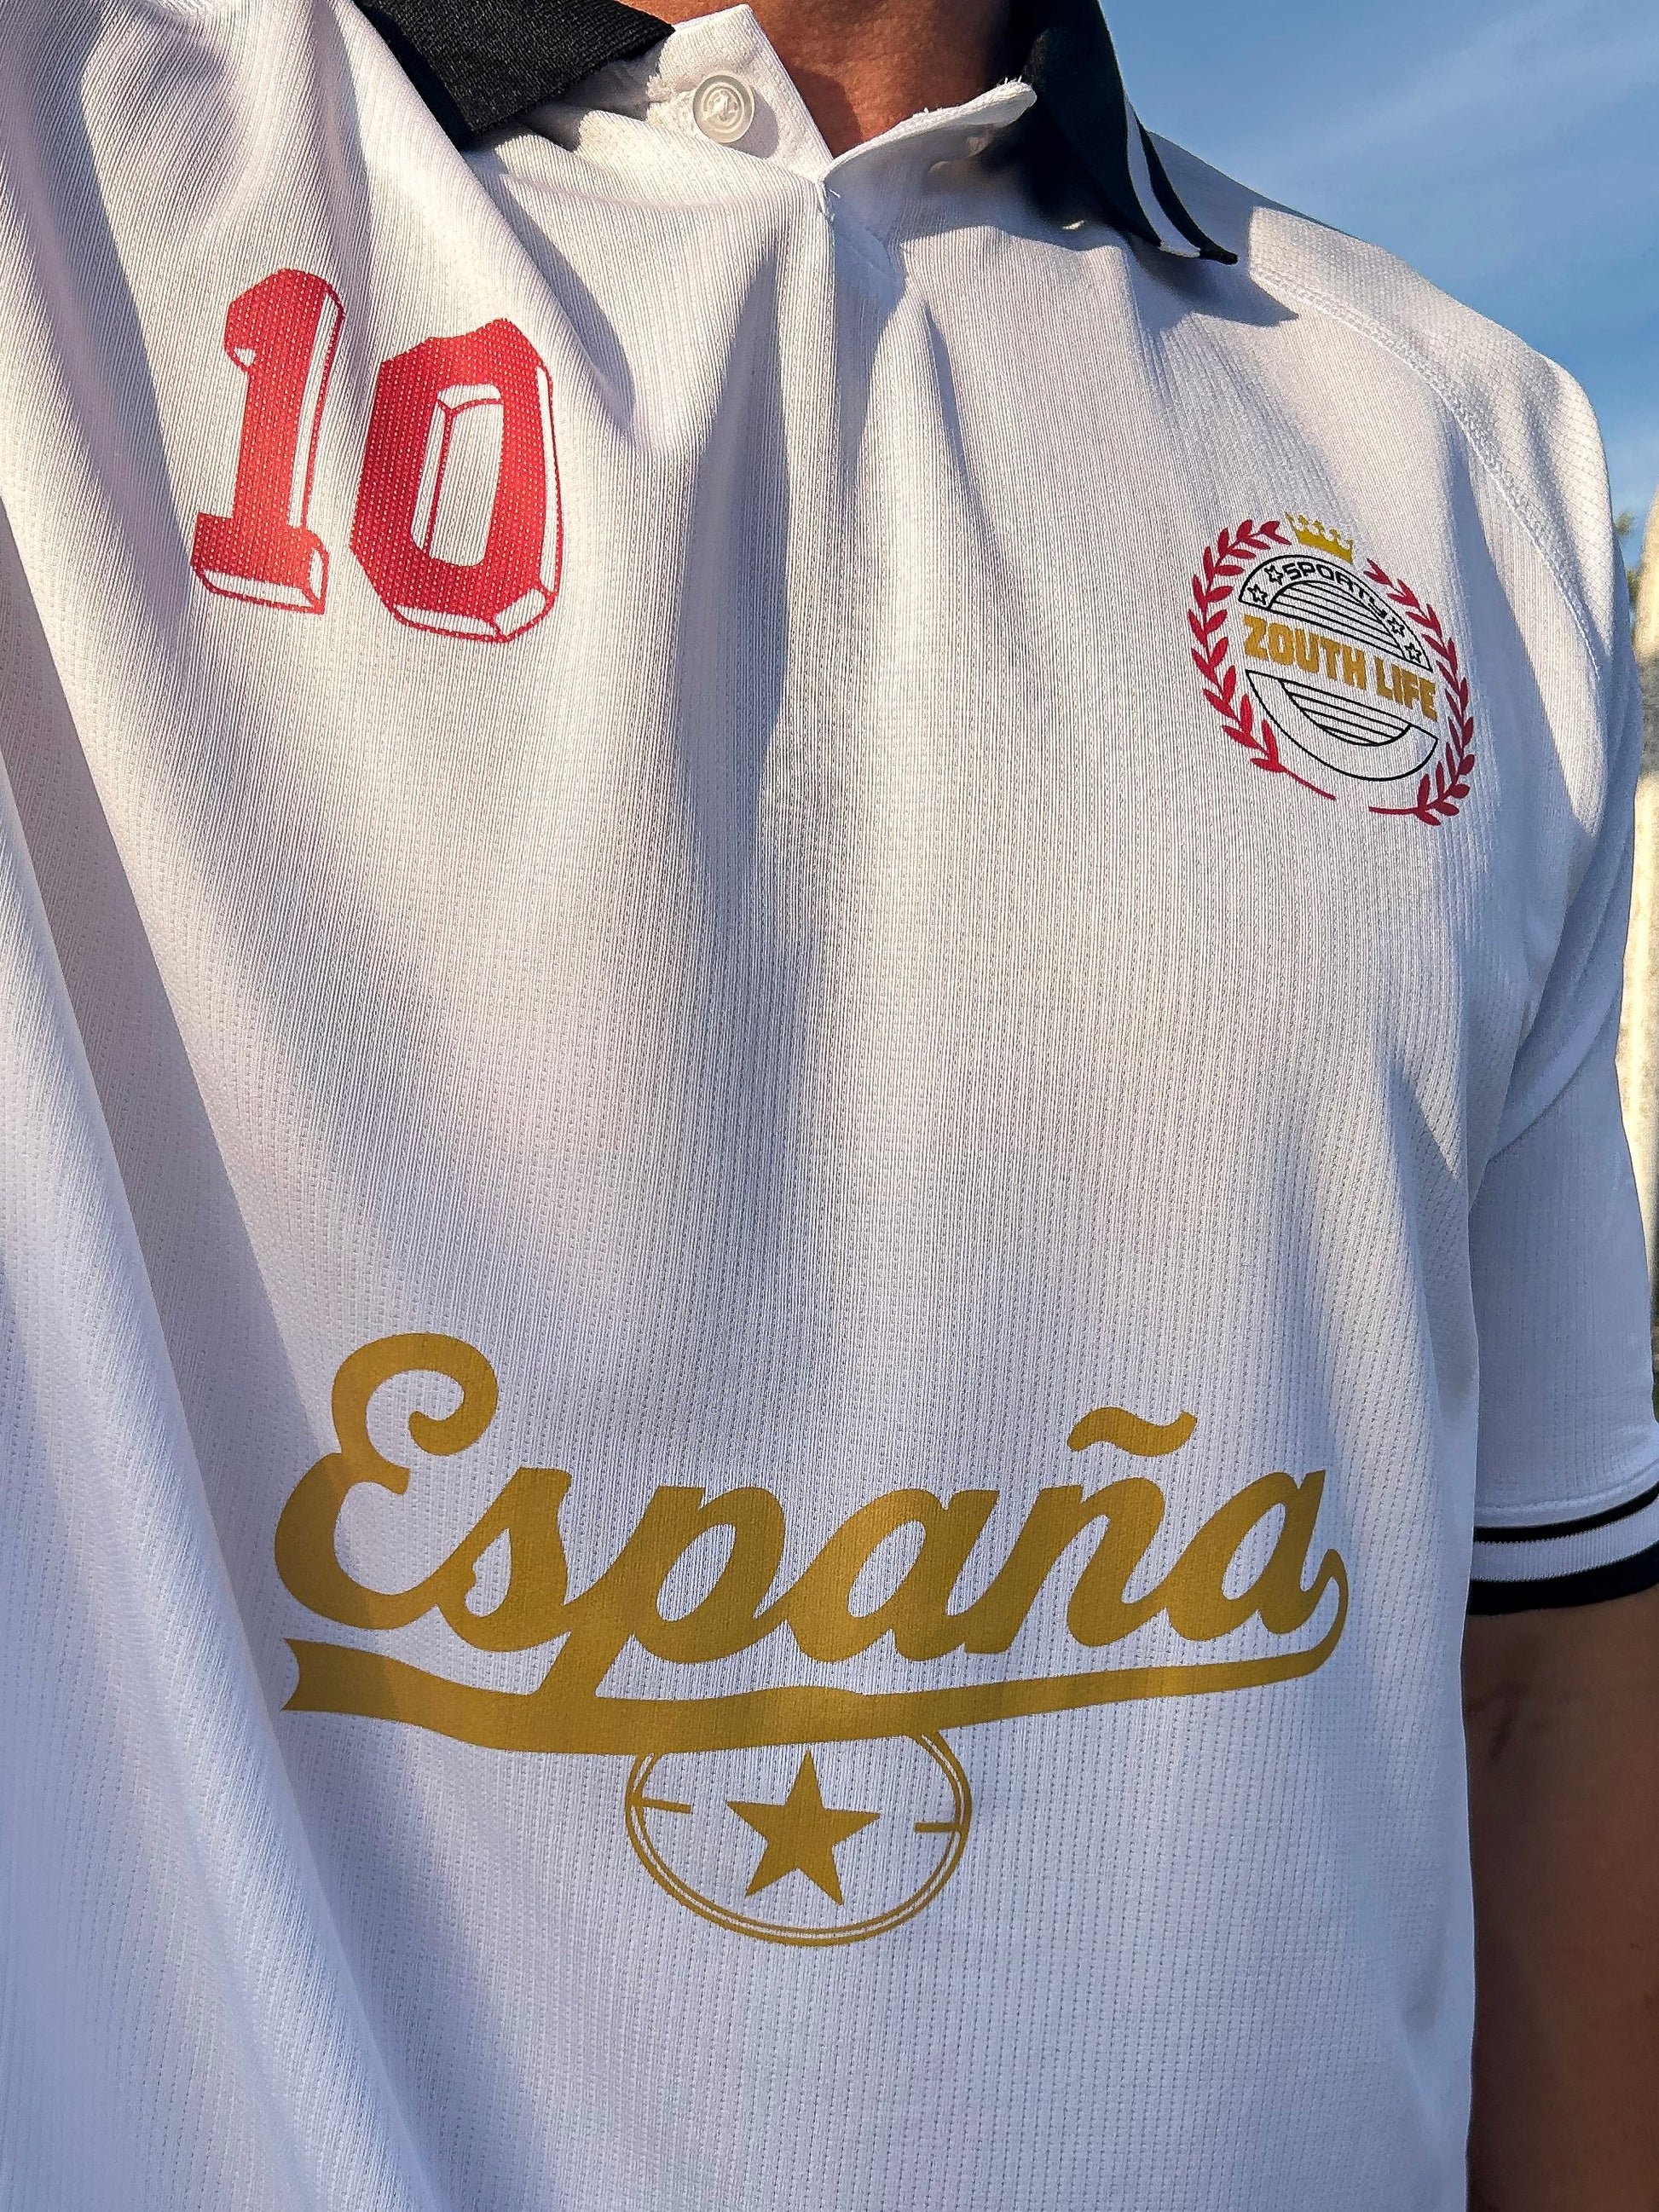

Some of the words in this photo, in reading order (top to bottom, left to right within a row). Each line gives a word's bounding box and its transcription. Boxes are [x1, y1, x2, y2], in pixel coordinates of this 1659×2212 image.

[190, 268, 564, 643] 10
[1243, 615, 1367, 690] ZOUTH
[1374, 656, 1438, 722] LIFE
[275, 1332, 1349, 1747] España
